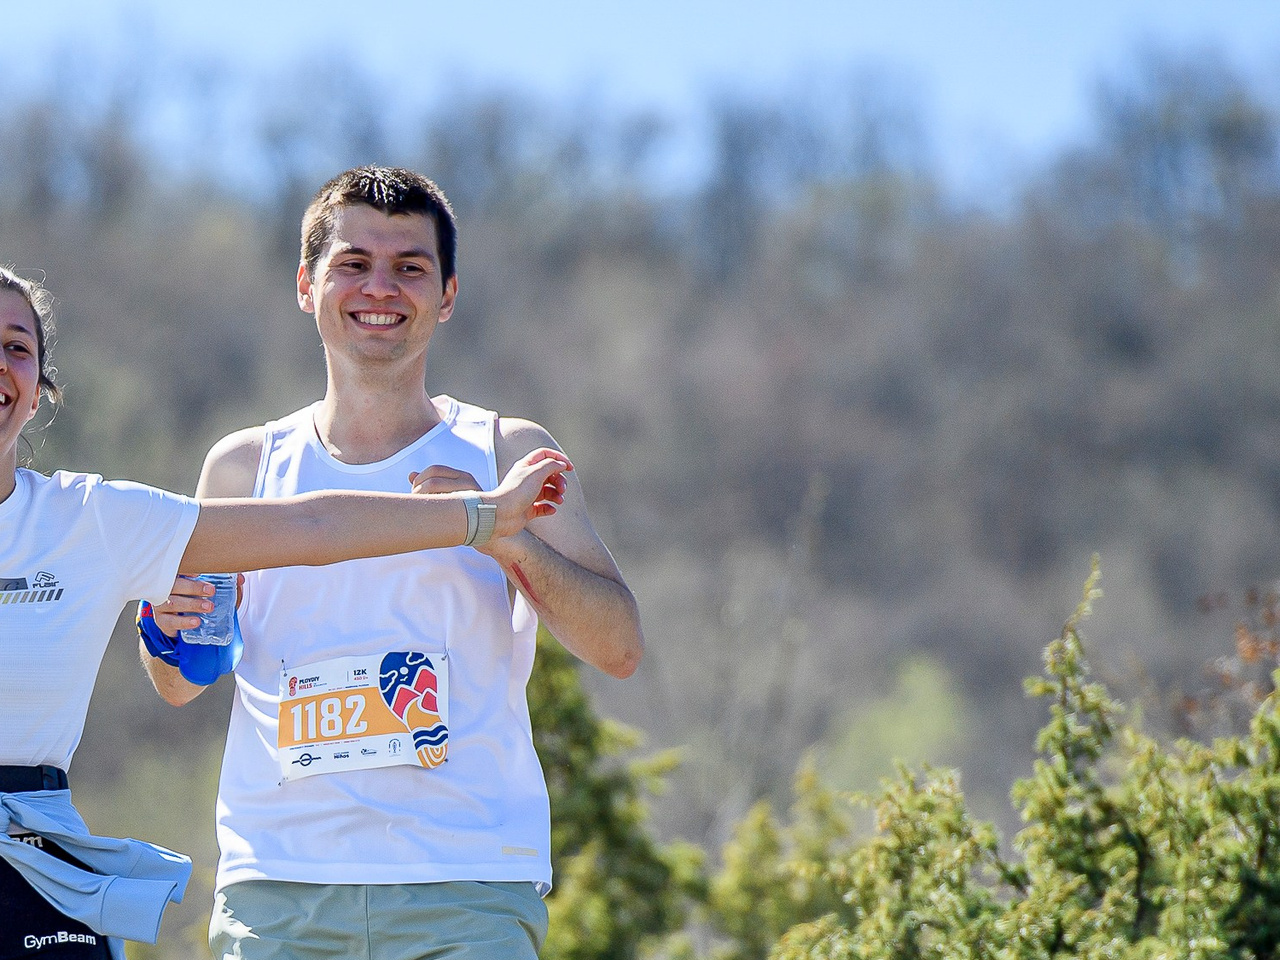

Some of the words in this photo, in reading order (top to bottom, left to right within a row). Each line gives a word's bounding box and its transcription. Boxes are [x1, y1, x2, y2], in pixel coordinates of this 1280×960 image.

[353, 668, 367, 676] 12K
[291, 694, 368, 741] 1182
[24, 931, 97, 949] GymBeam
